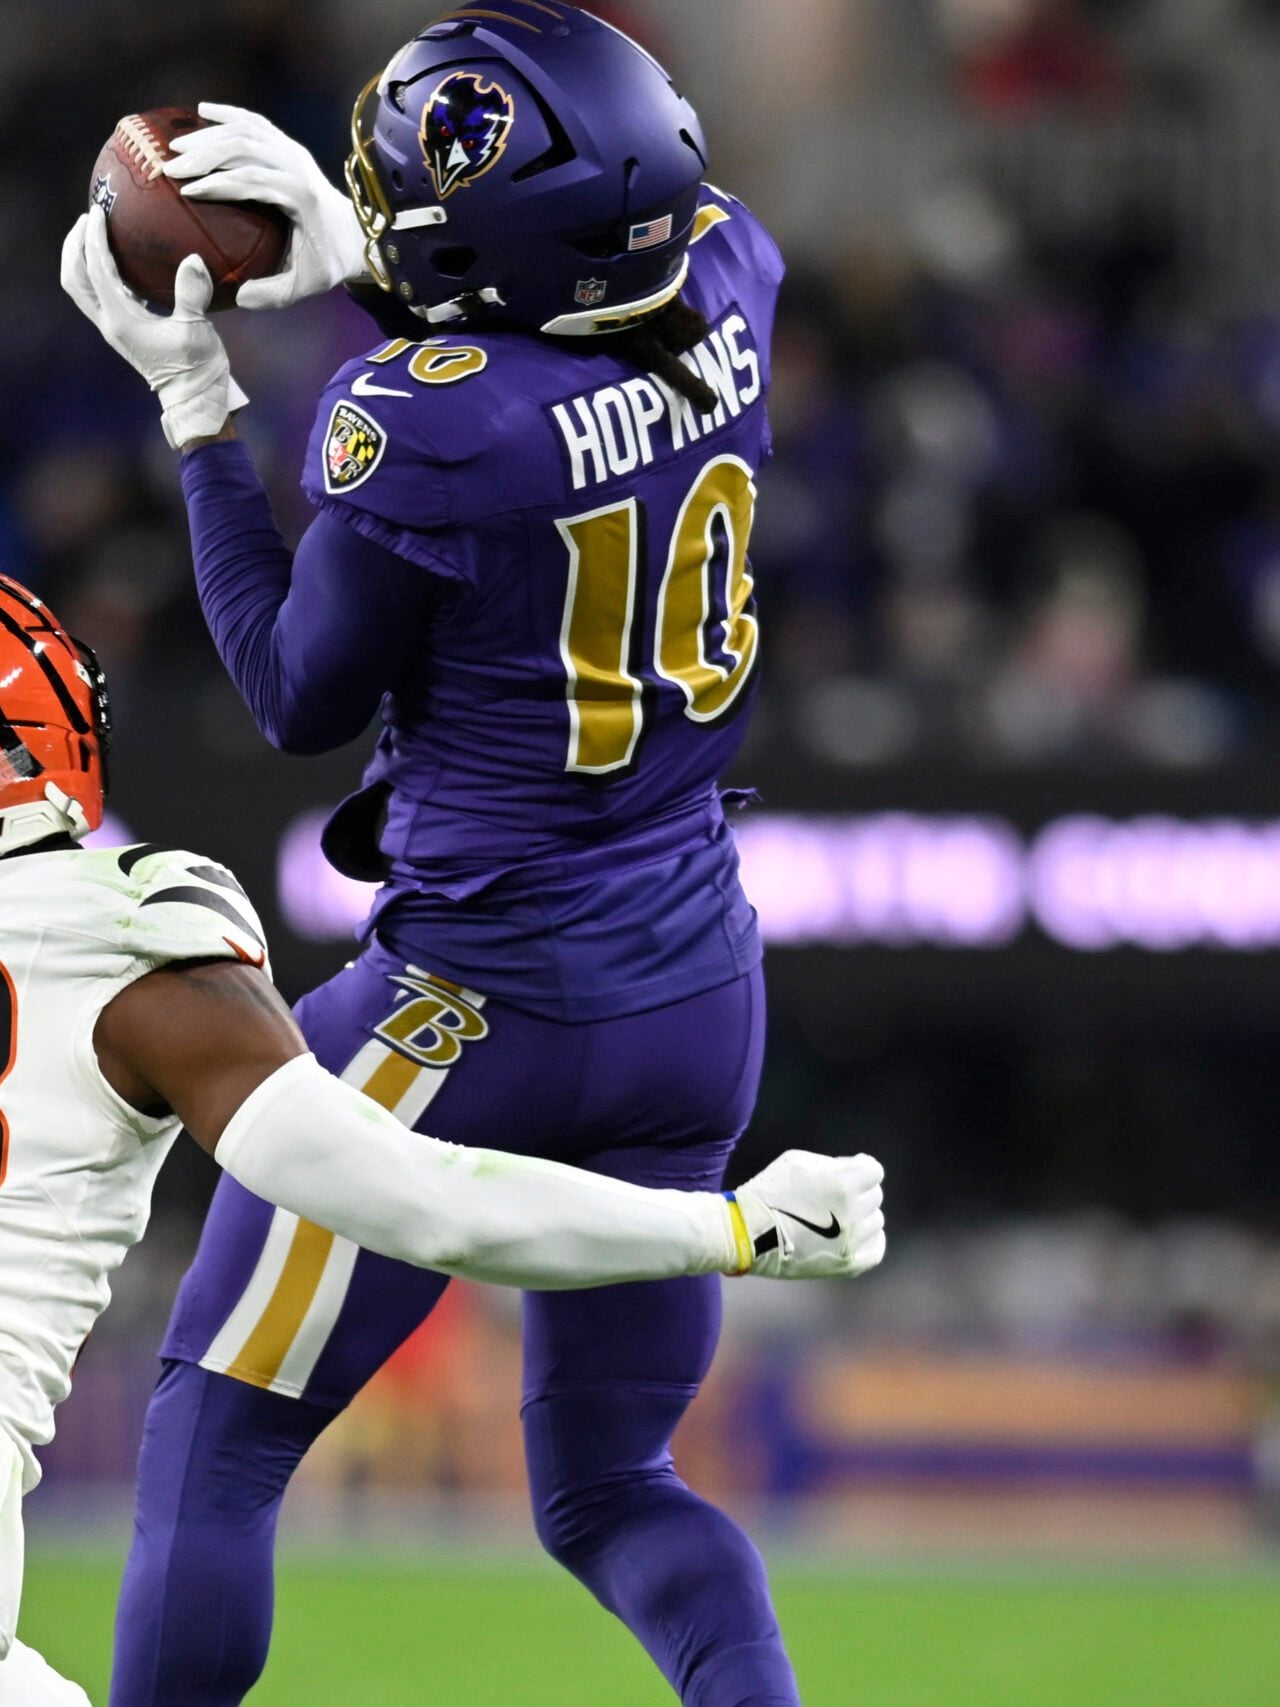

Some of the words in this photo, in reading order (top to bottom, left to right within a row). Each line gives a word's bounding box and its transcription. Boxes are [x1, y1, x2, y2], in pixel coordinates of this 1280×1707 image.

[338, 407, 377, 442] RAVENS
[554, 453, 758, 775] 10
[373, 975, 489, 1066] B
